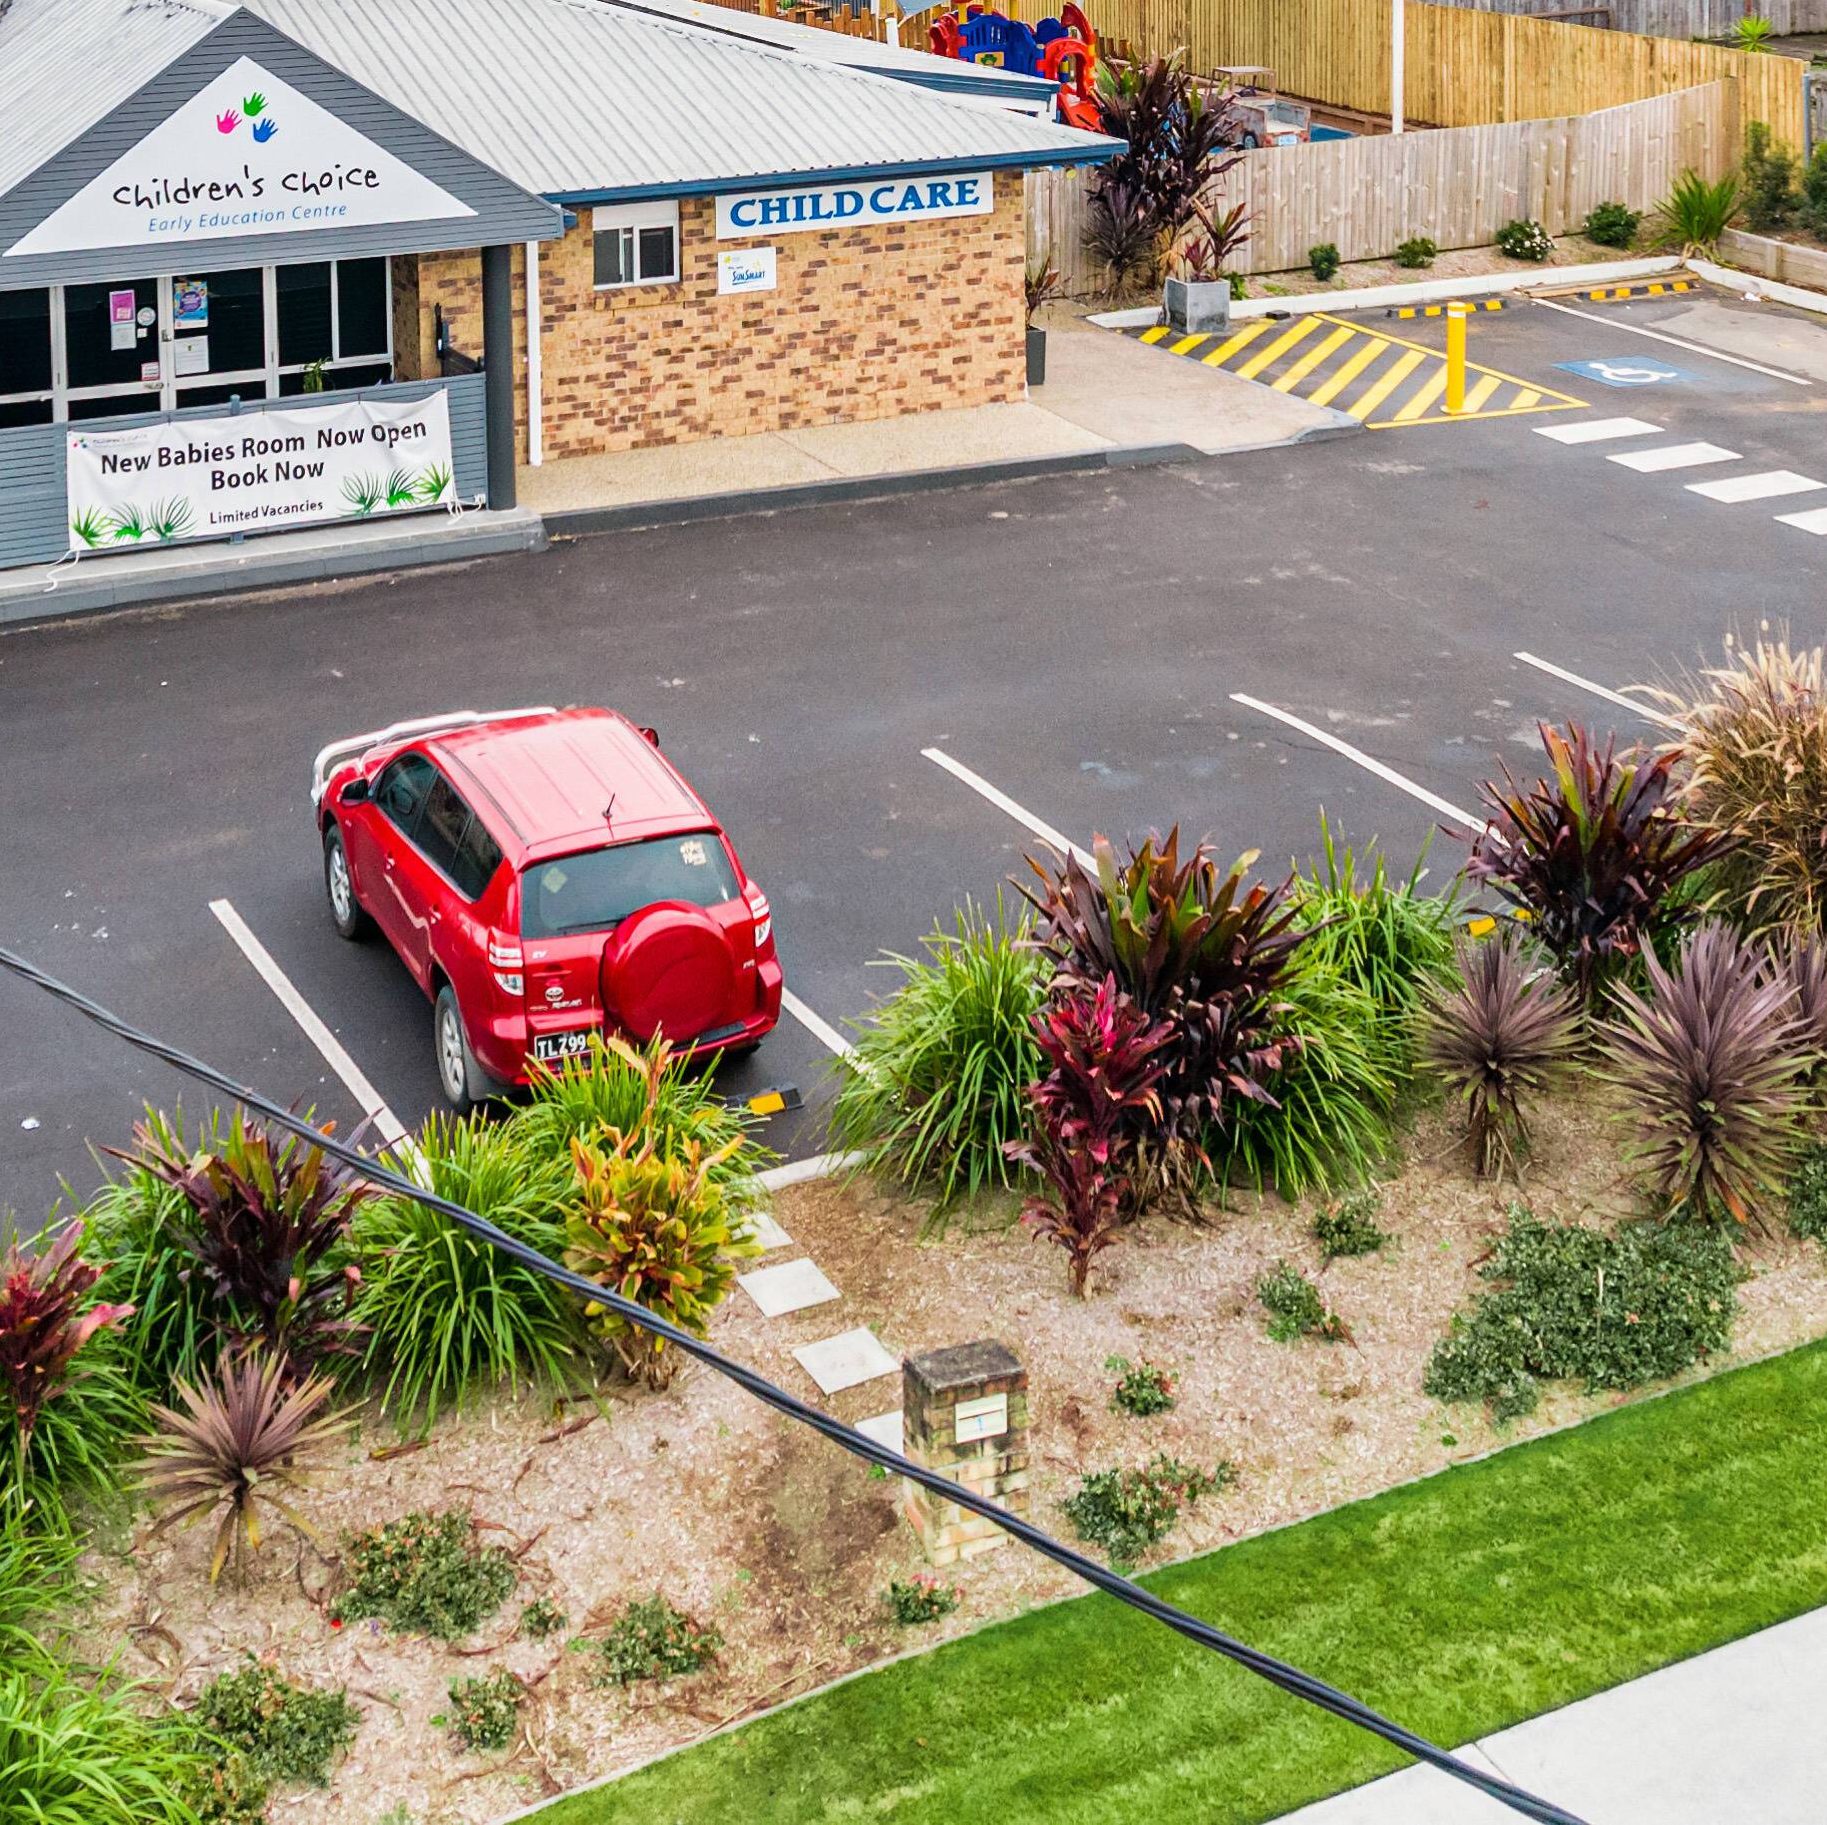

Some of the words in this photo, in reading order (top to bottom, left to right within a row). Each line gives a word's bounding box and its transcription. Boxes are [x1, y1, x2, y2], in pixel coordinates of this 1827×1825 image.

[730, 190, 864, 227] CHILD
[869, 178, 980, 214] CARE
[148, 215, 192, 233] Early
[199, 209, 285, 228] Education
[292, 204, 347, 220] Centre
[101, 454, 152, 475] New
[158, 441, 235, 468] Babies
[241, 435, 305, 458] Room
[317, 427, 365, 449] Now
[371, 421, 427, 449] Open
[211, 463, 269, 491] Book
[275, 460, 325, 482] Now
[209, 506, 259, 524] Limited
[261, 499, 323, 517] Vacancies
